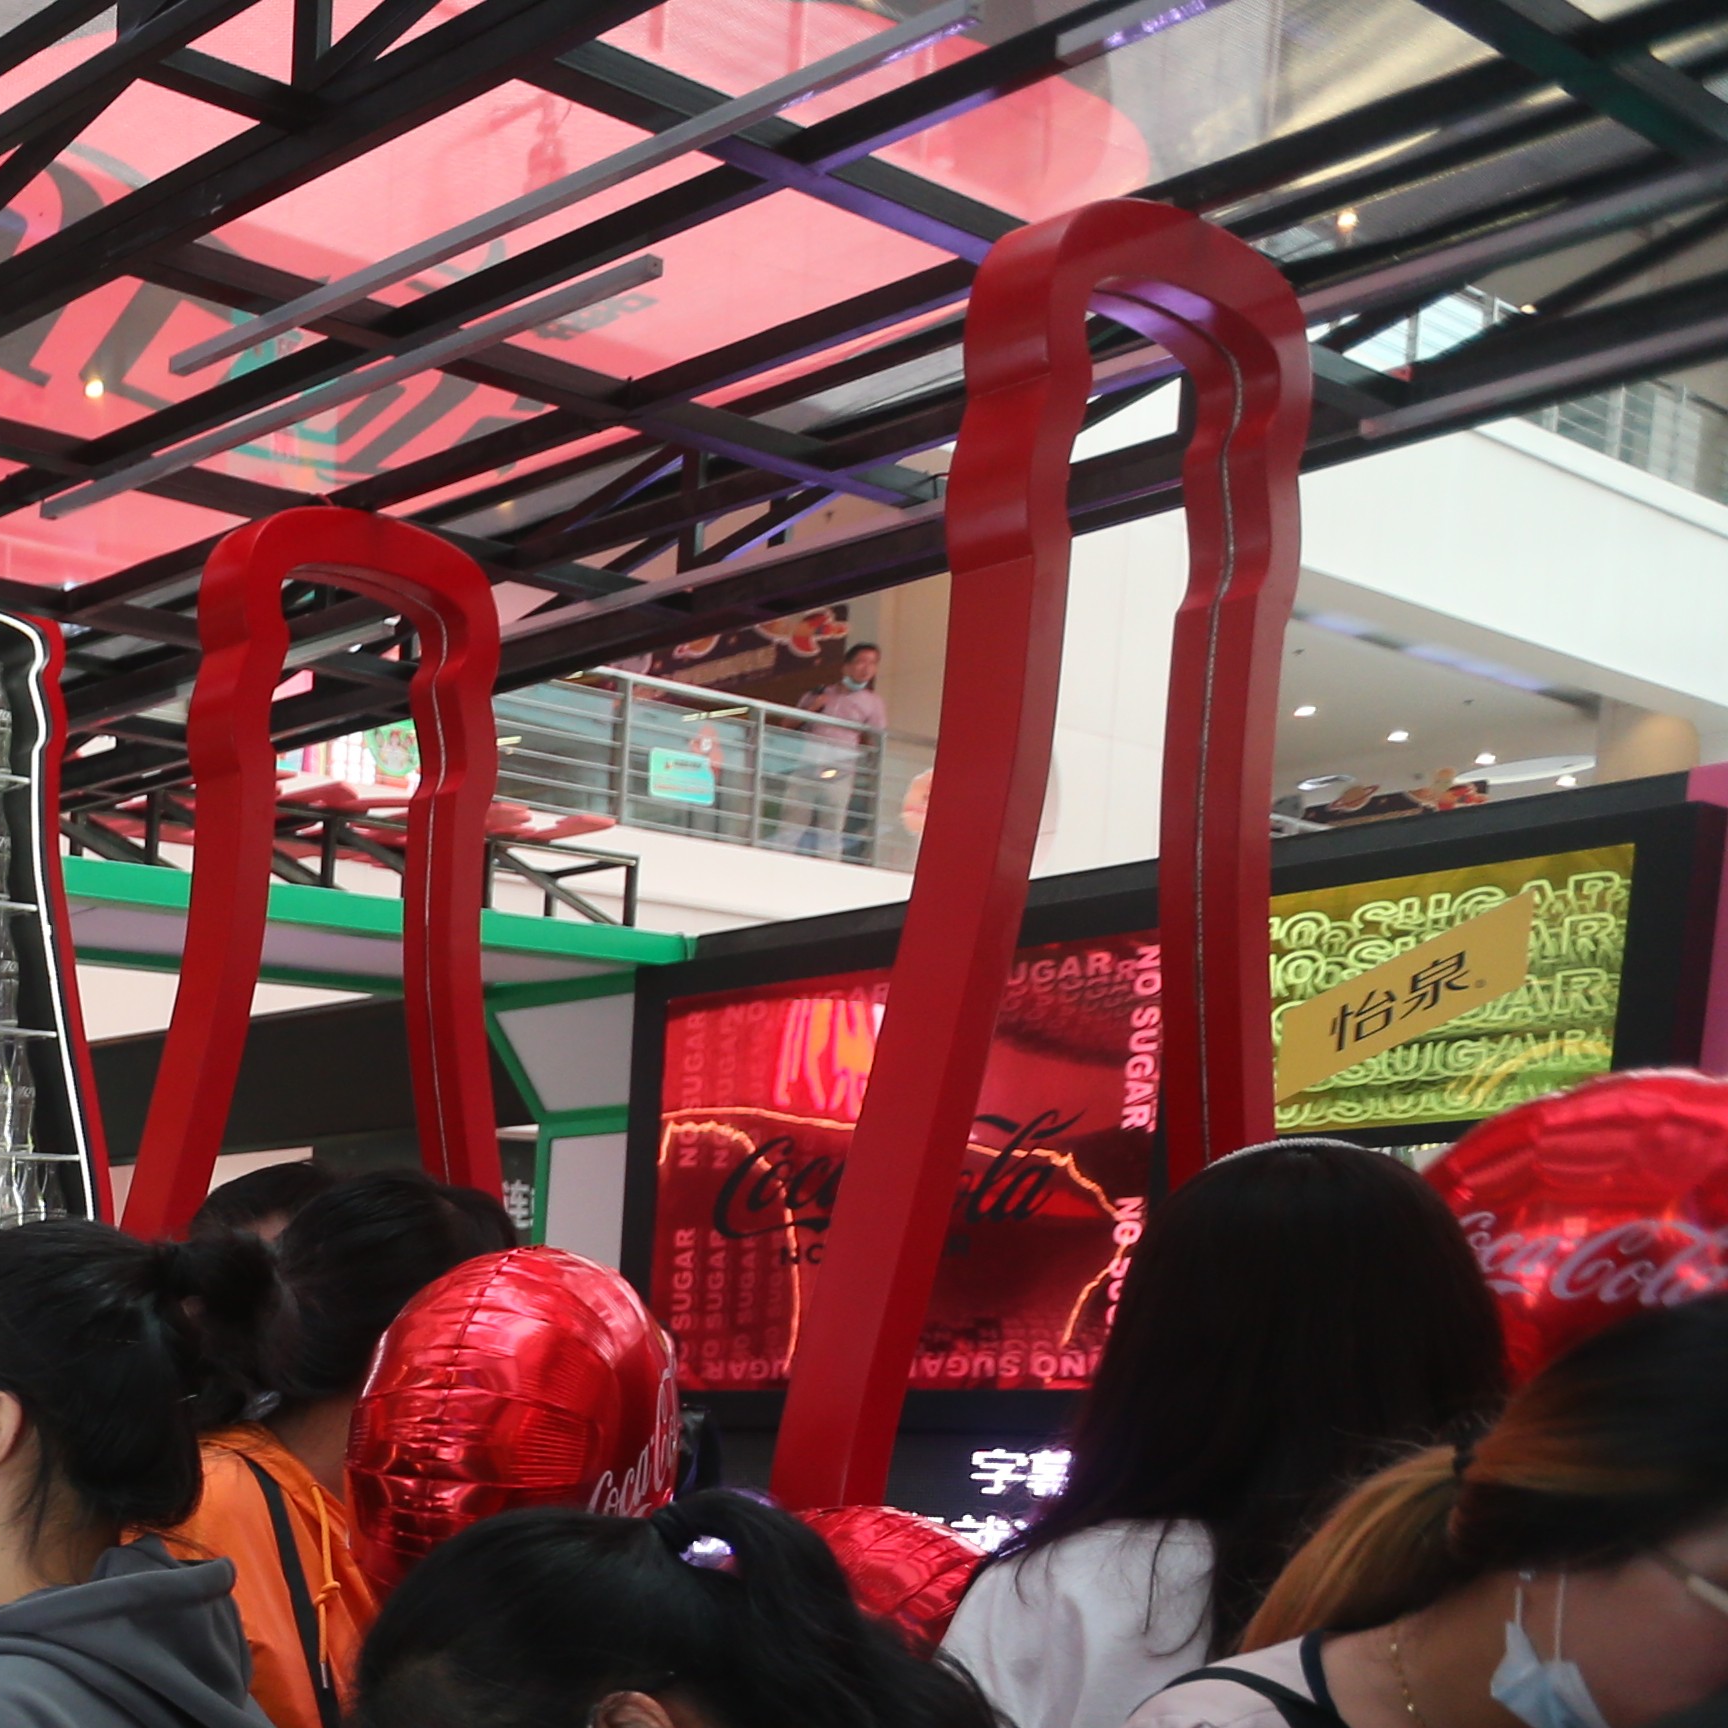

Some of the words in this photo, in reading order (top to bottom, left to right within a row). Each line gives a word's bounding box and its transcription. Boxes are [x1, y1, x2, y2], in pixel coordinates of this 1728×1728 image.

[1133, 943, 1162, 997] NO
[1330, 950, 1470, 1052] 怡泉
[1120, 1004, 1162, 1134] SUGAR
[669, 1226, 698, 1331] SUGAR
[908, 1353, 1026, 1381] SUGA
